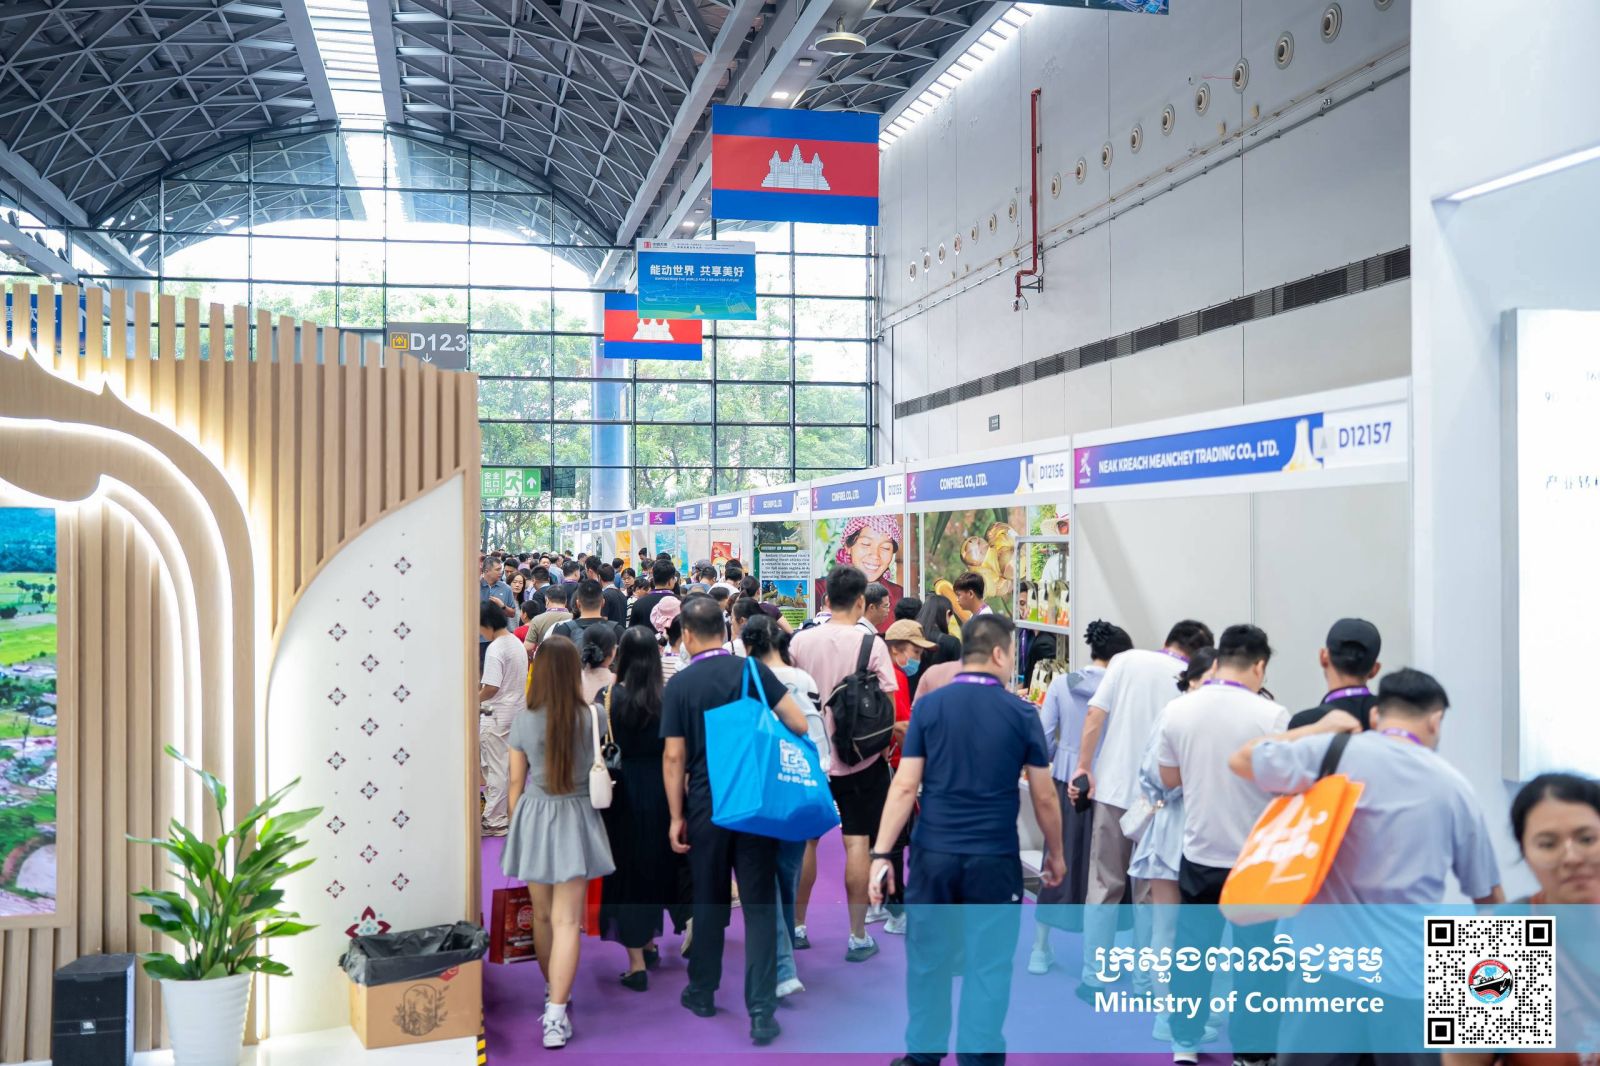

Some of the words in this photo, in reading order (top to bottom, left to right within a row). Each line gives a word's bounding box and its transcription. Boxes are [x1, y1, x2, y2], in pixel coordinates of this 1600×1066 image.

[650, 264, 694, 276] 能动世界
[700, 265, 744, 277] 共享美好
[1338, 421, 1392, 448] D12157
[1098, 458, 1118, 474] NEAK
[1118, 455, 1148, 472] KREACH
[1149, 449, 1195, 469] MEANCHEY
[1195, 445, 1236, 464] TRADING
[1236, 442, 1256, 461] CO.,
[1257, 439, 1279, 457] LTD.
[1039, 463, 1064, 480] D12156
